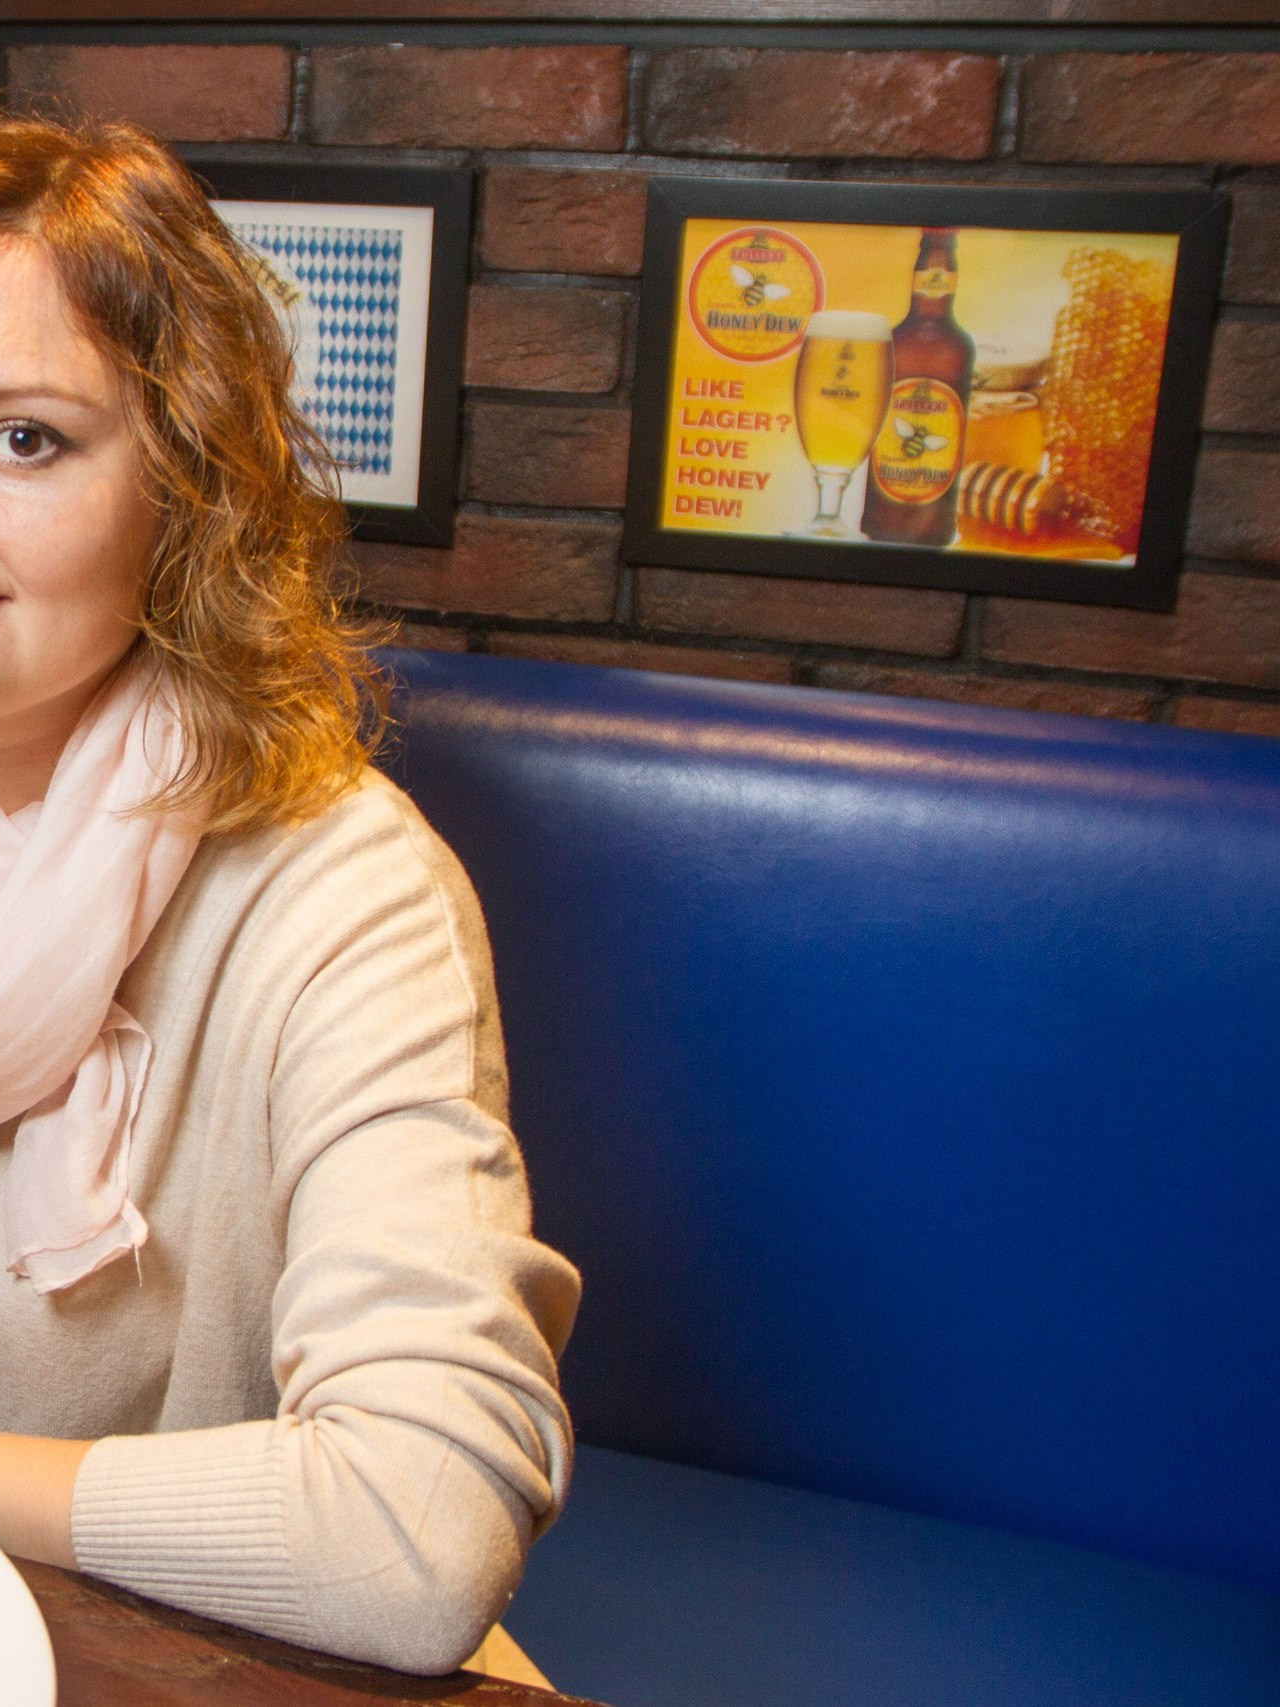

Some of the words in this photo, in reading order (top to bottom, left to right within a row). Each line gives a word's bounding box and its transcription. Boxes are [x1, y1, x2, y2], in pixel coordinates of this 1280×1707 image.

[706, 309, 764, 331] HONEY
[764, 312, 801, 333] DEW
[683, 377, 744, 400] LIKE
[678, 436, 749, 460] LOVE
[675, 464, 771, 491] HONEY
[673, 494, 744, 519] DEW!
